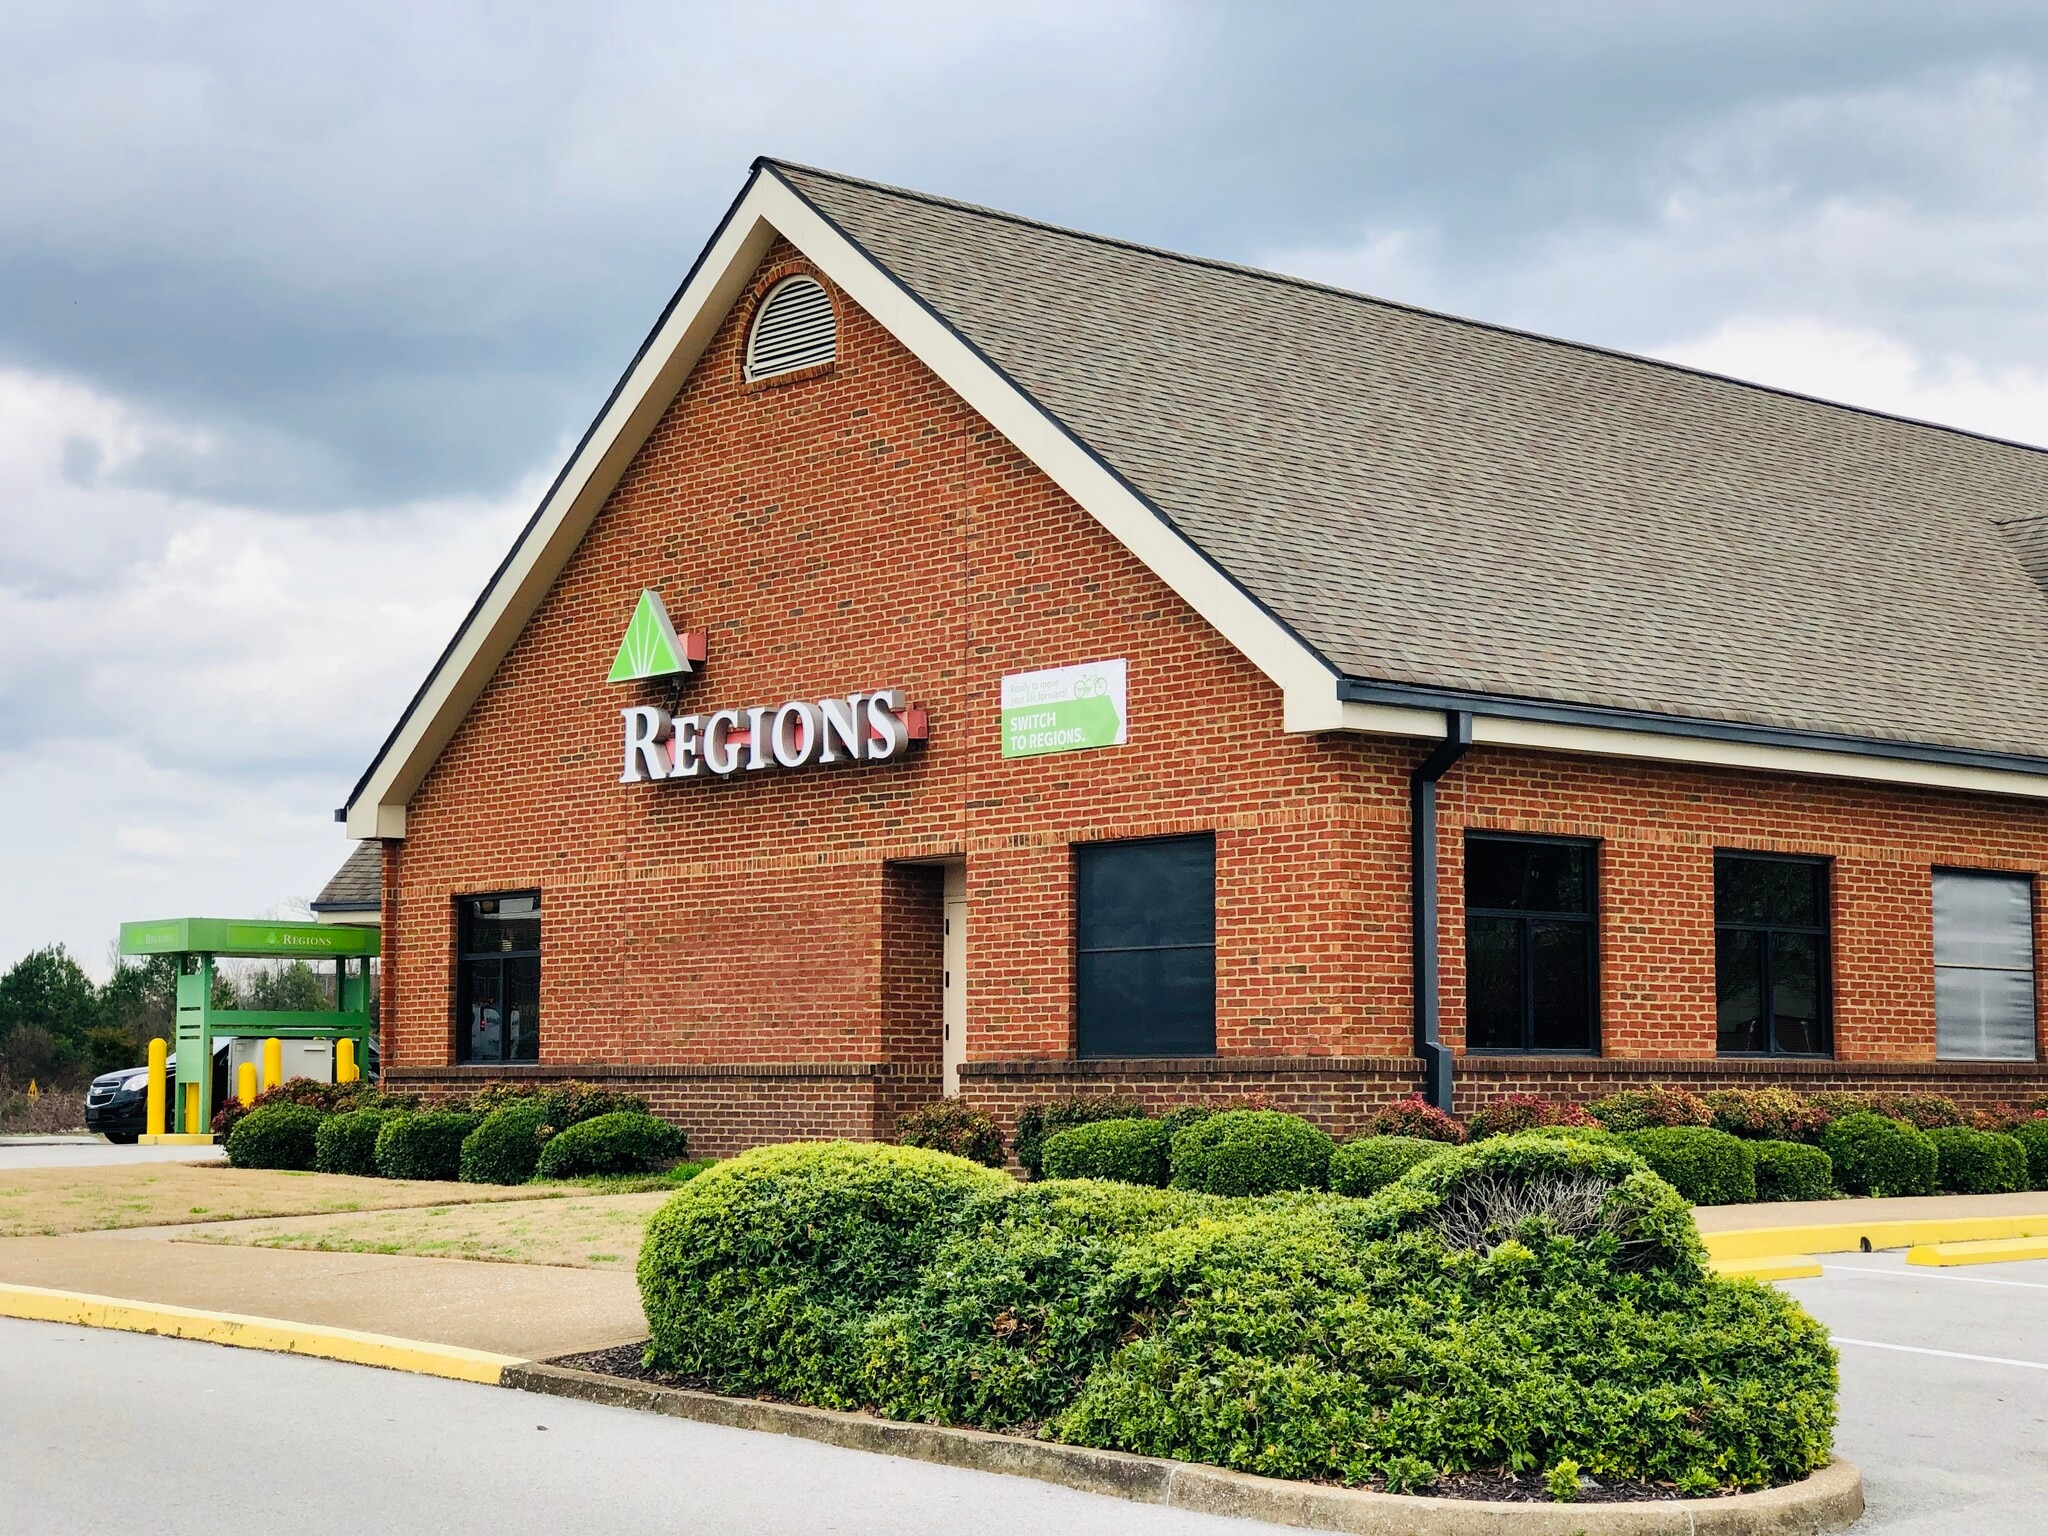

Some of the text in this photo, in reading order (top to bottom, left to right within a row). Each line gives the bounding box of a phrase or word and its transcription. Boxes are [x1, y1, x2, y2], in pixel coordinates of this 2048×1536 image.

[1010, 680, 1059, 694] Ready to move
[1010, 696, 1025, 706] your
[1026, 691, 1036, 702] life
[1010, 712, 1056, 732] SWITCH
[619, 690, 908, 783] REGIONS
[1010, 727, 1086, 750] TO REGIONS.
[283, 934, 332, 946] REGIONS
